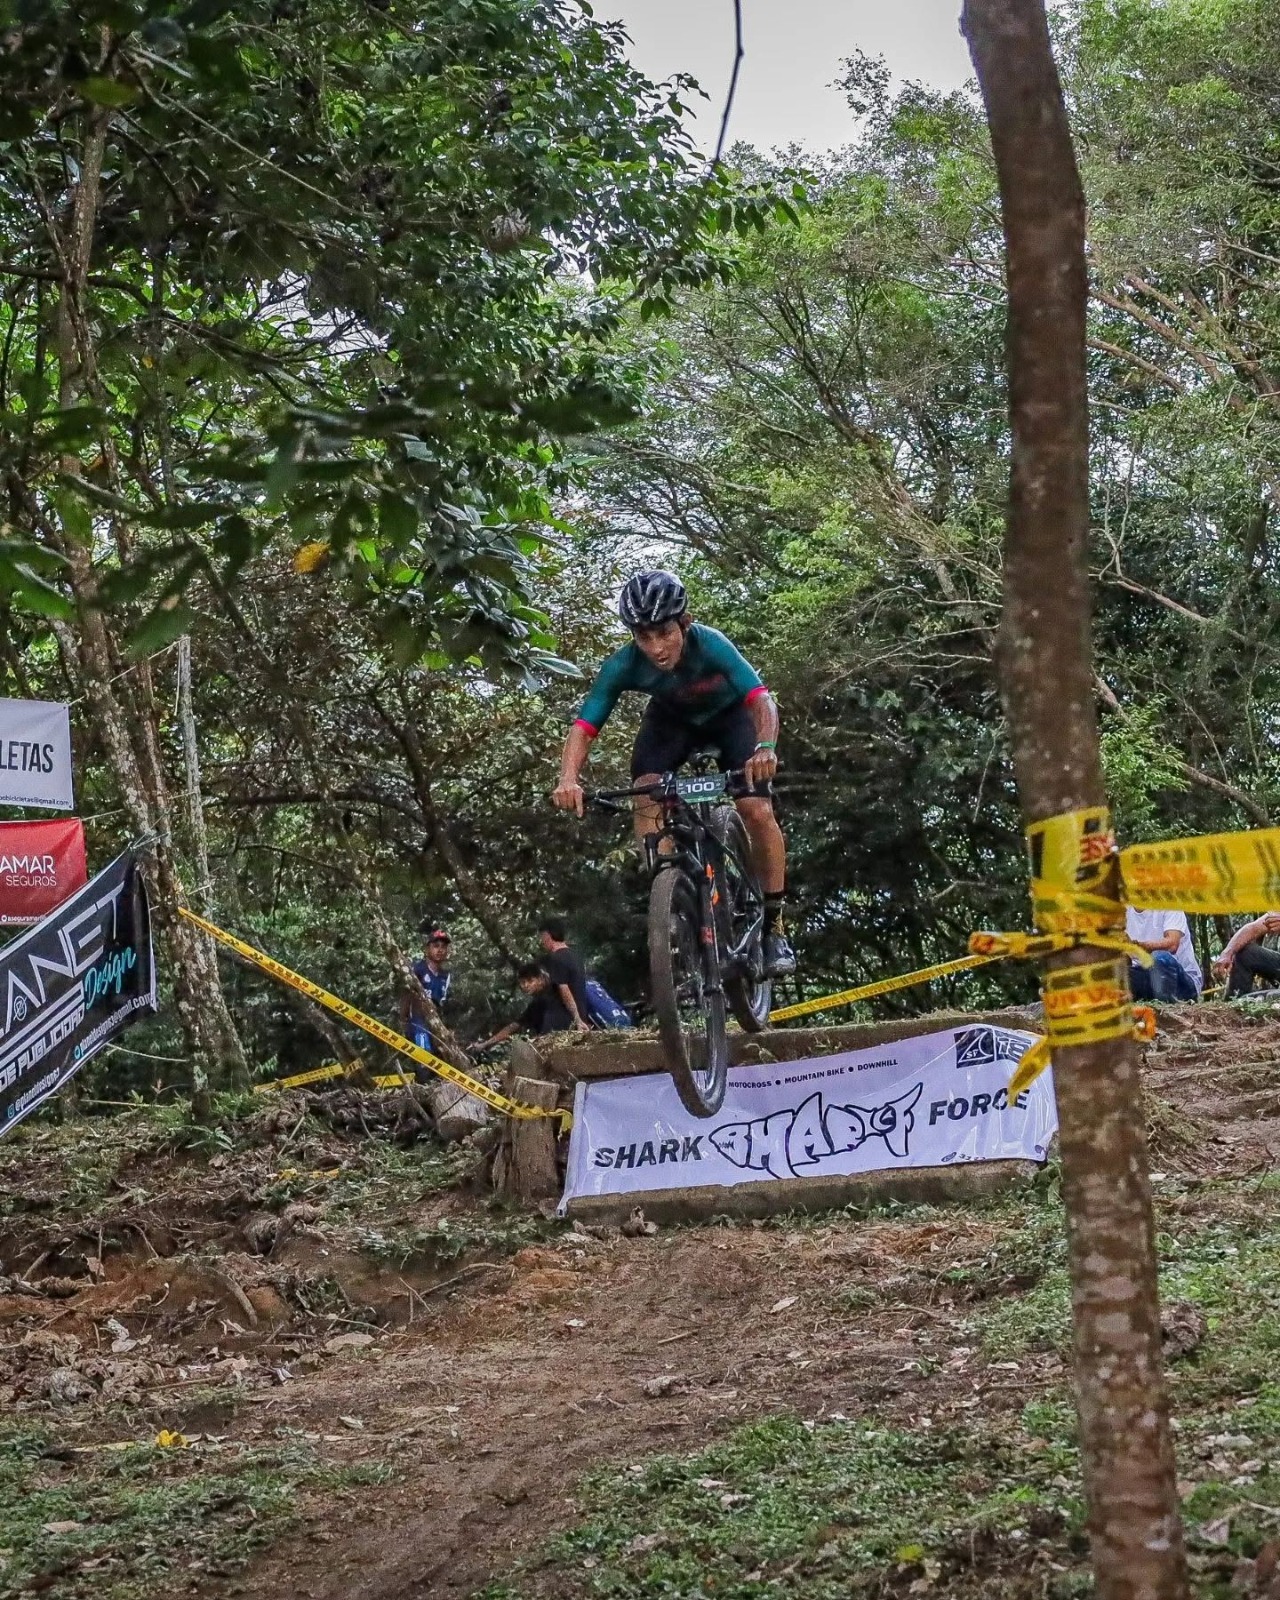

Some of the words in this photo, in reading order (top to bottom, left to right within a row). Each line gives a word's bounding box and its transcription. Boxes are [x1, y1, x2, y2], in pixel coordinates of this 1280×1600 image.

[0, 740, 54, 773] LETAS
[686, 782, 714, 793] 100
[0, 855, 56, 874] AMAR
[6, 875, 57, 887] SEGUROS
[0, 881, 125, 1036] ANET
[85, 946, 136, 1010] Design
[18, 1002, 85, 1077] PUBLICIDAD
[728, 1080, 772, 1089] MOTOCROSS
[784, 1071, 825, 1085] MOUNTAIN
[827, 1067, 845, 1077] BIKE
[857, 1059, 898, 1071] DOWNHILL
[594, 1136, 704, 1169] SHARK
[929, 1088, 1030, 1125] FORCE
